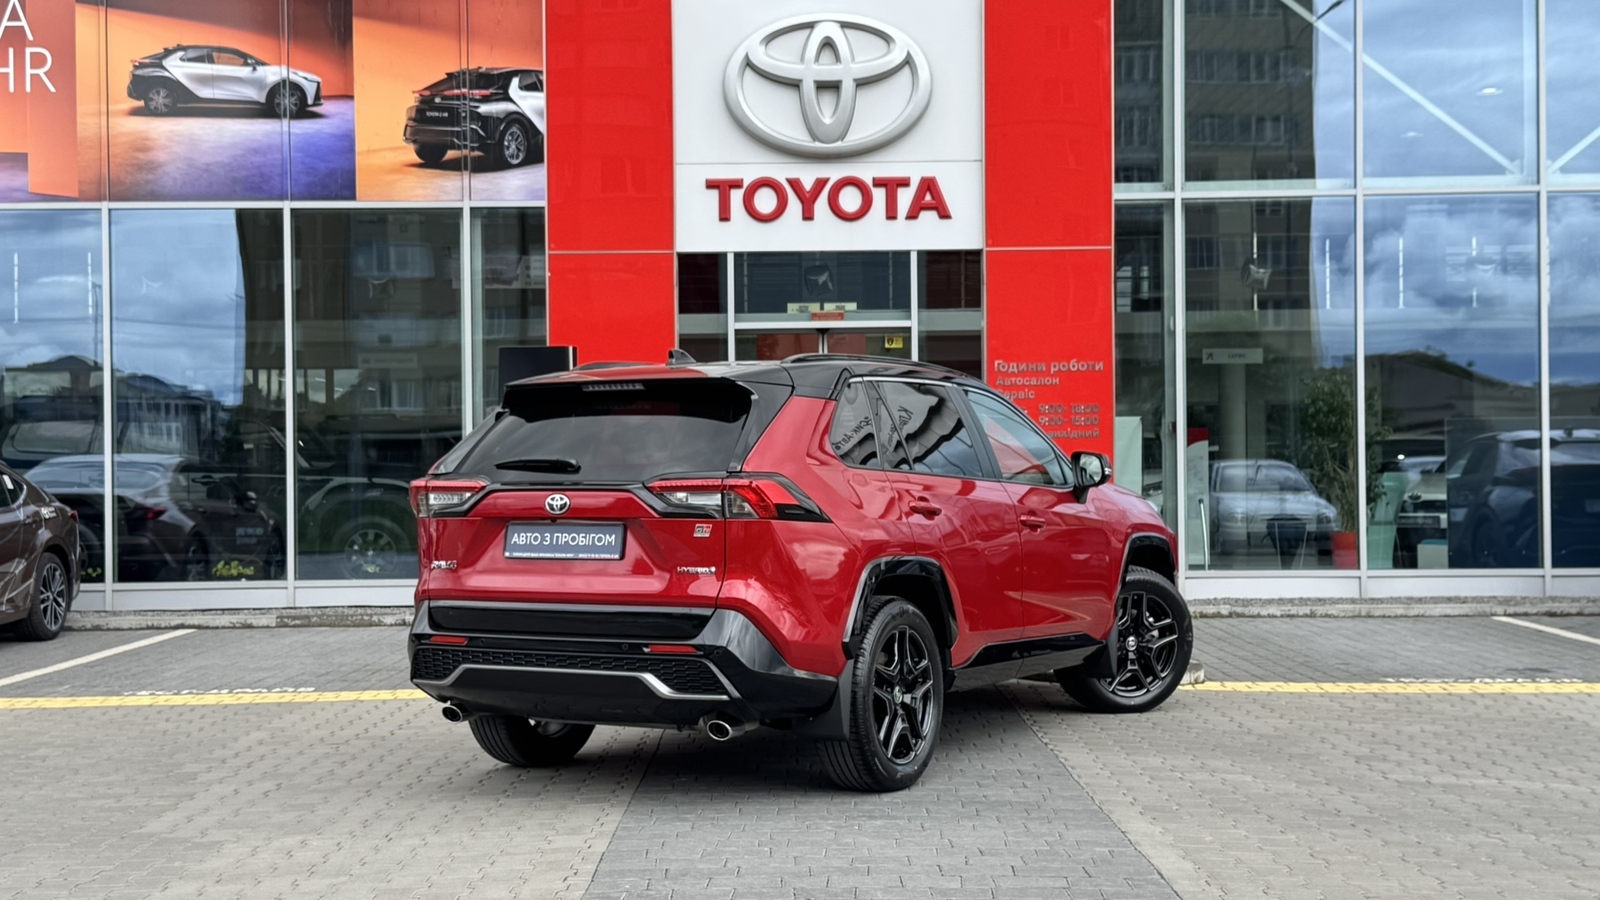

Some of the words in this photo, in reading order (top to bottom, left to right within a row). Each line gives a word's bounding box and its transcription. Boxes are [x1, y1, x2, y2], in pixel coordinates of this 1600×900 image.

[705, 176, 952, 222] TOYOTA
[994, 360, 1046, 374] Години
[1050, 358, 1104, 374] роботи
[996, 376, 1060, 386] Автосалон
[511, 532, 541, 545] АВТО
[553, 533, 616, 546] ПРОБІГОМ
